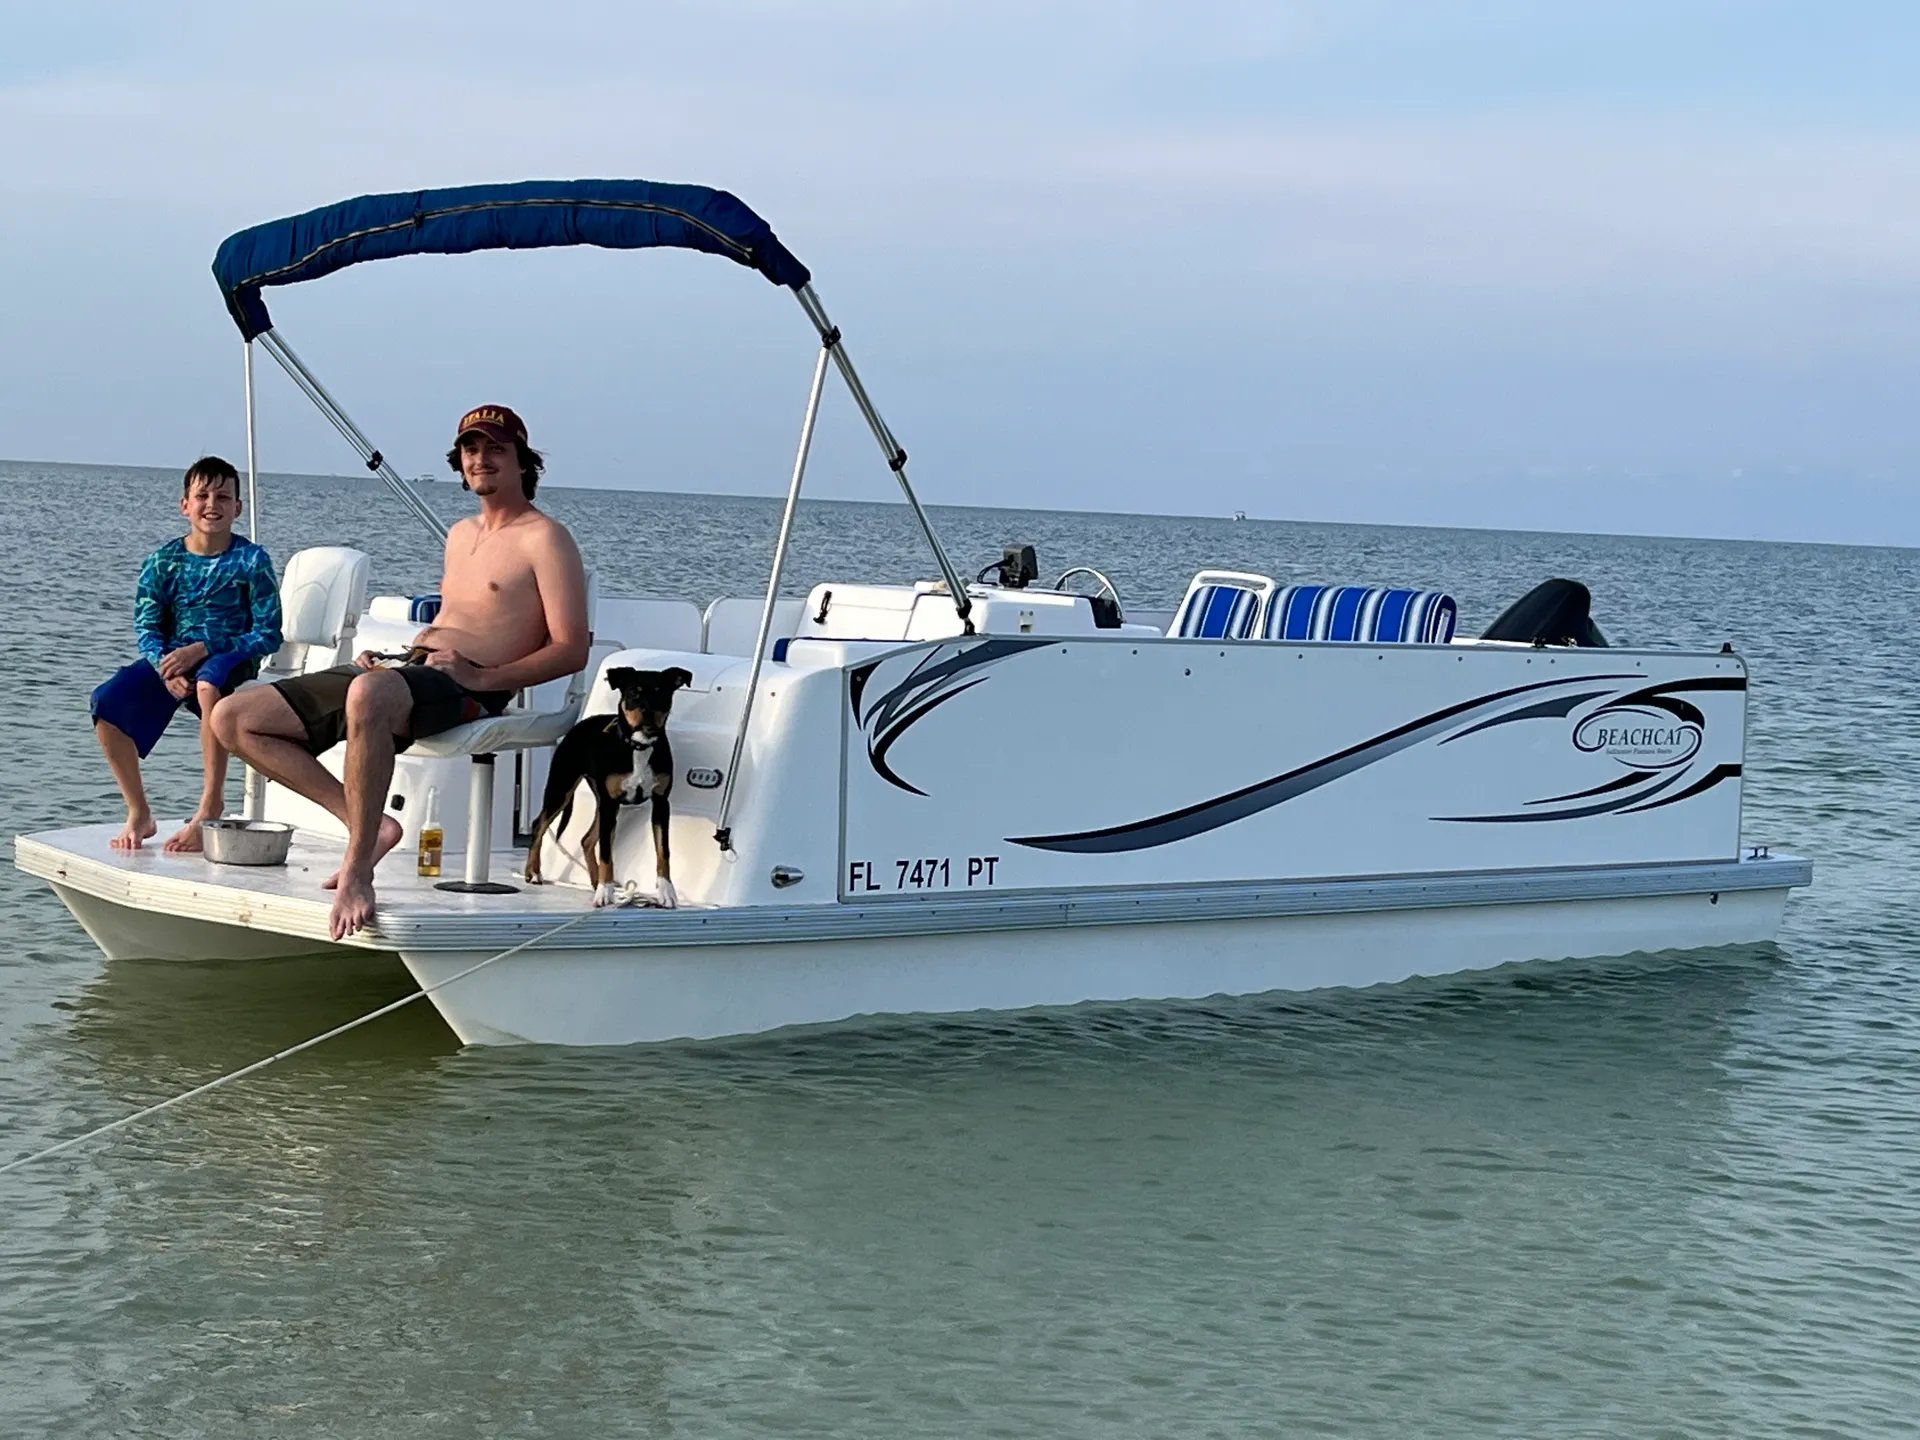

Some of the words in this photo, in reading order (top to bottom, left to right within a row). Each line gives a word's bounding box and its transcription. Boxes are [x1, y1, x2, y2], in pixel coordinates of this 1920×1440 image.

[463, 409, 505, 428] ITALIA
[849, 861, 881, 892] FL
[896, 858, 950, 889] 7471
[968, 856, 999, 886] PT
